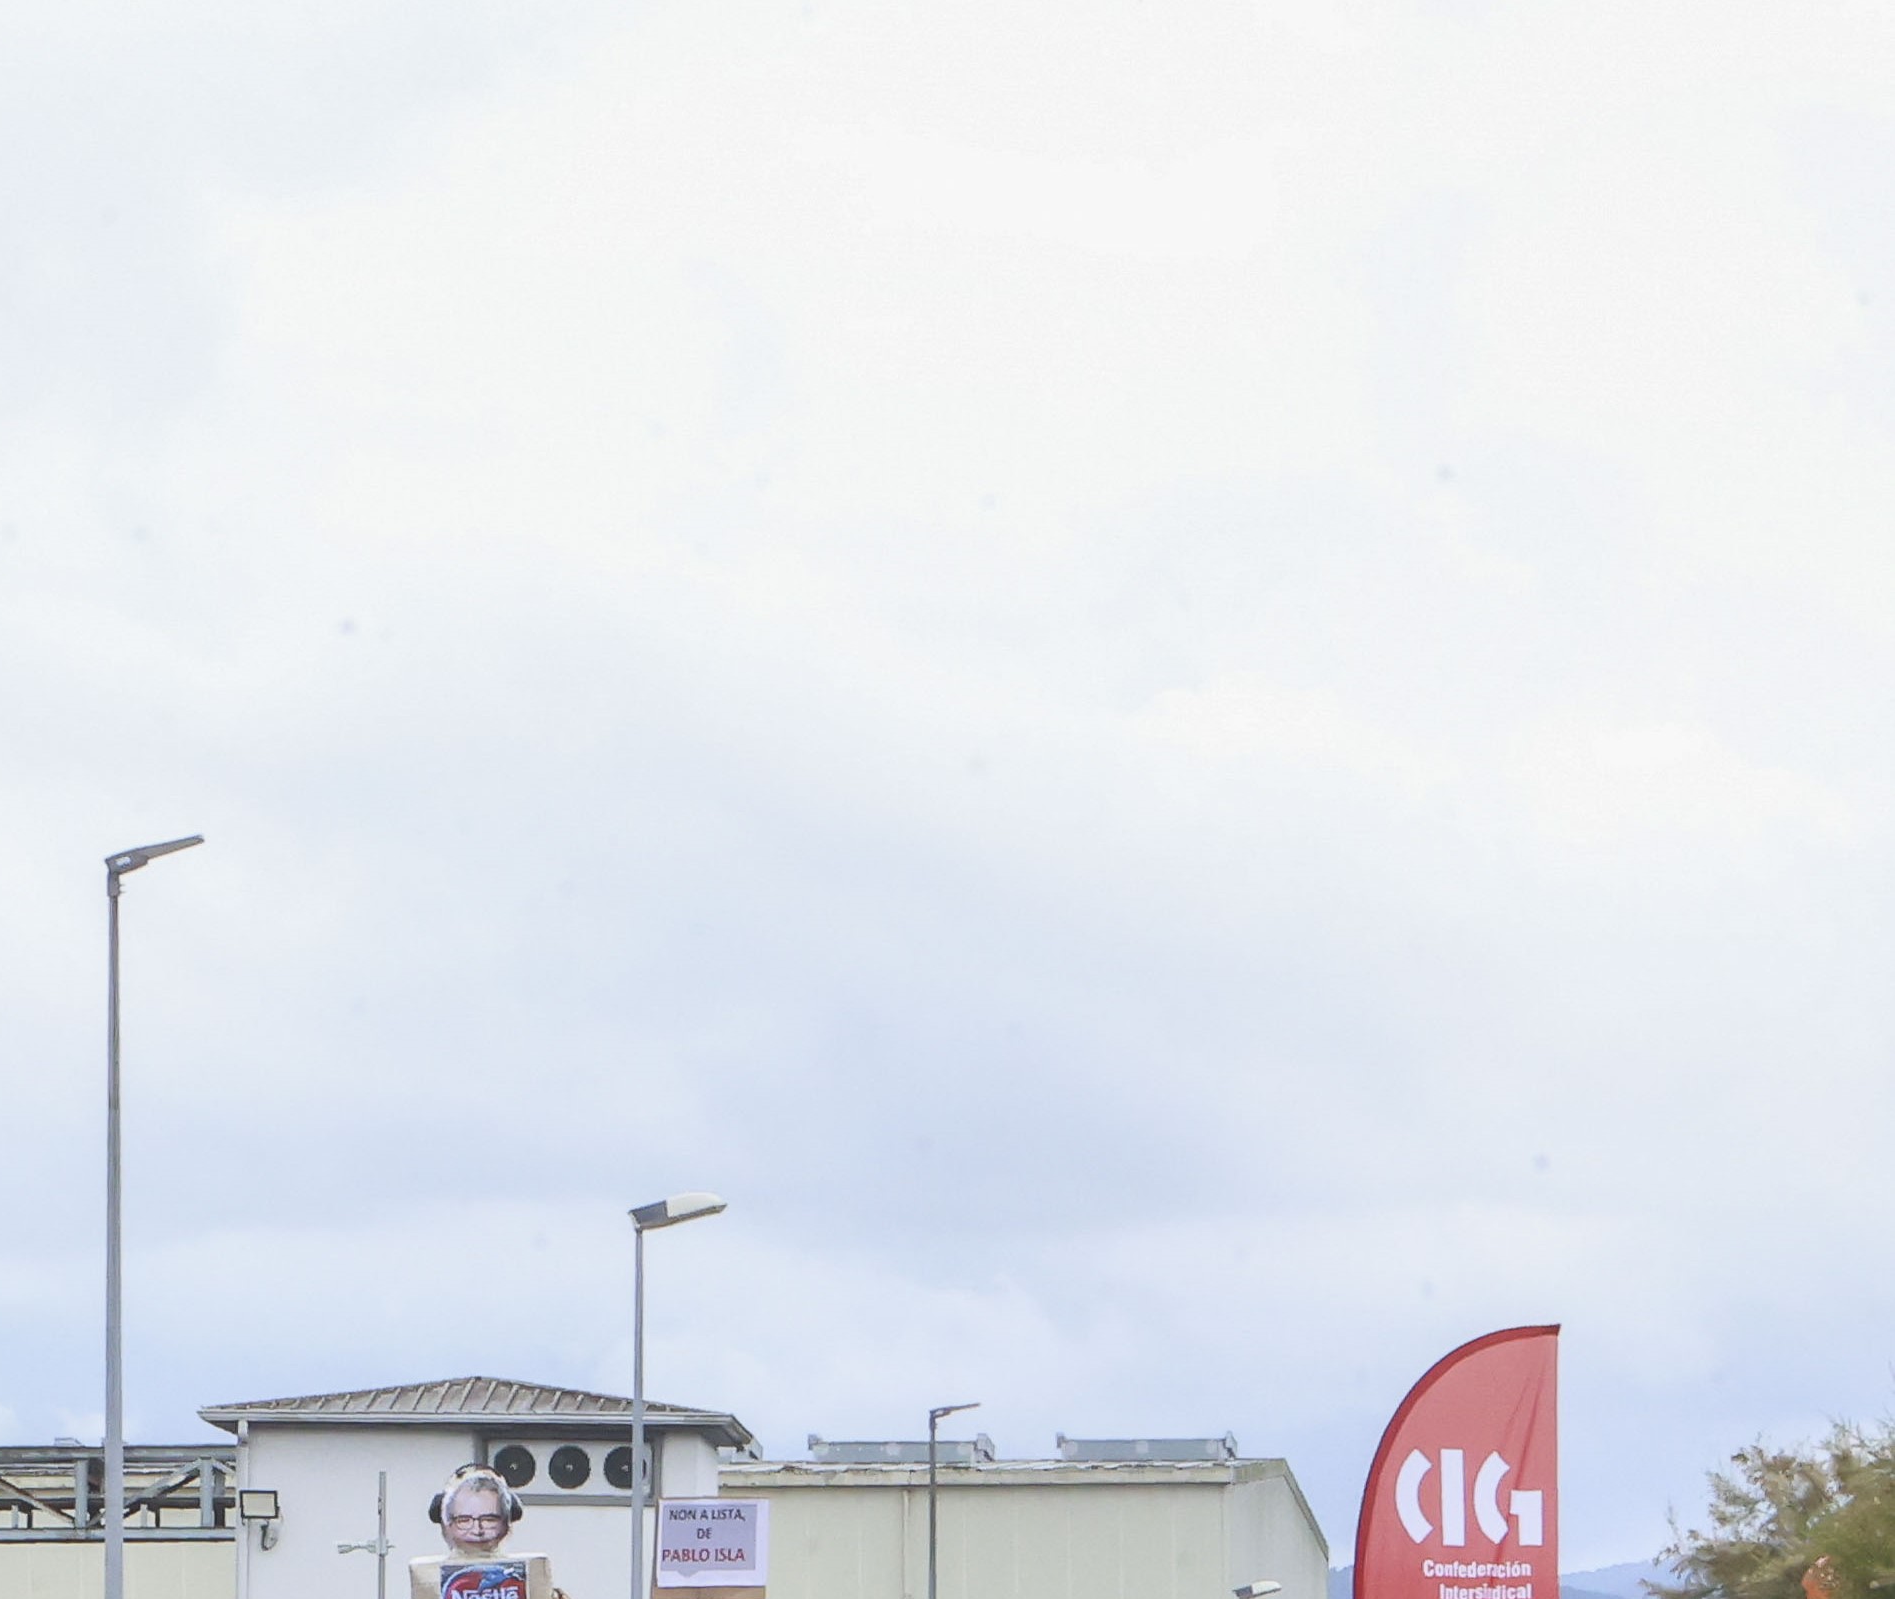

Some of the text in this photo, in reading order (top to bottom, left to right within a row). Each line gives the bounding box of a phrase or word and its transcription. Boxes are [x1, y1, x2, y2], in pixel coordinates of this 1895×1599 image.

[1395, 1448, 1543, 1547] CIG
[669, 1509, 696, 1521] NON
[699, 1509, 709, 1520] A
[696, 1527, 713, 1540] DE
[662, 1548, 747, 1562] PABLO ISLA
[1422, 1559, 1533, 1578] Confederación
